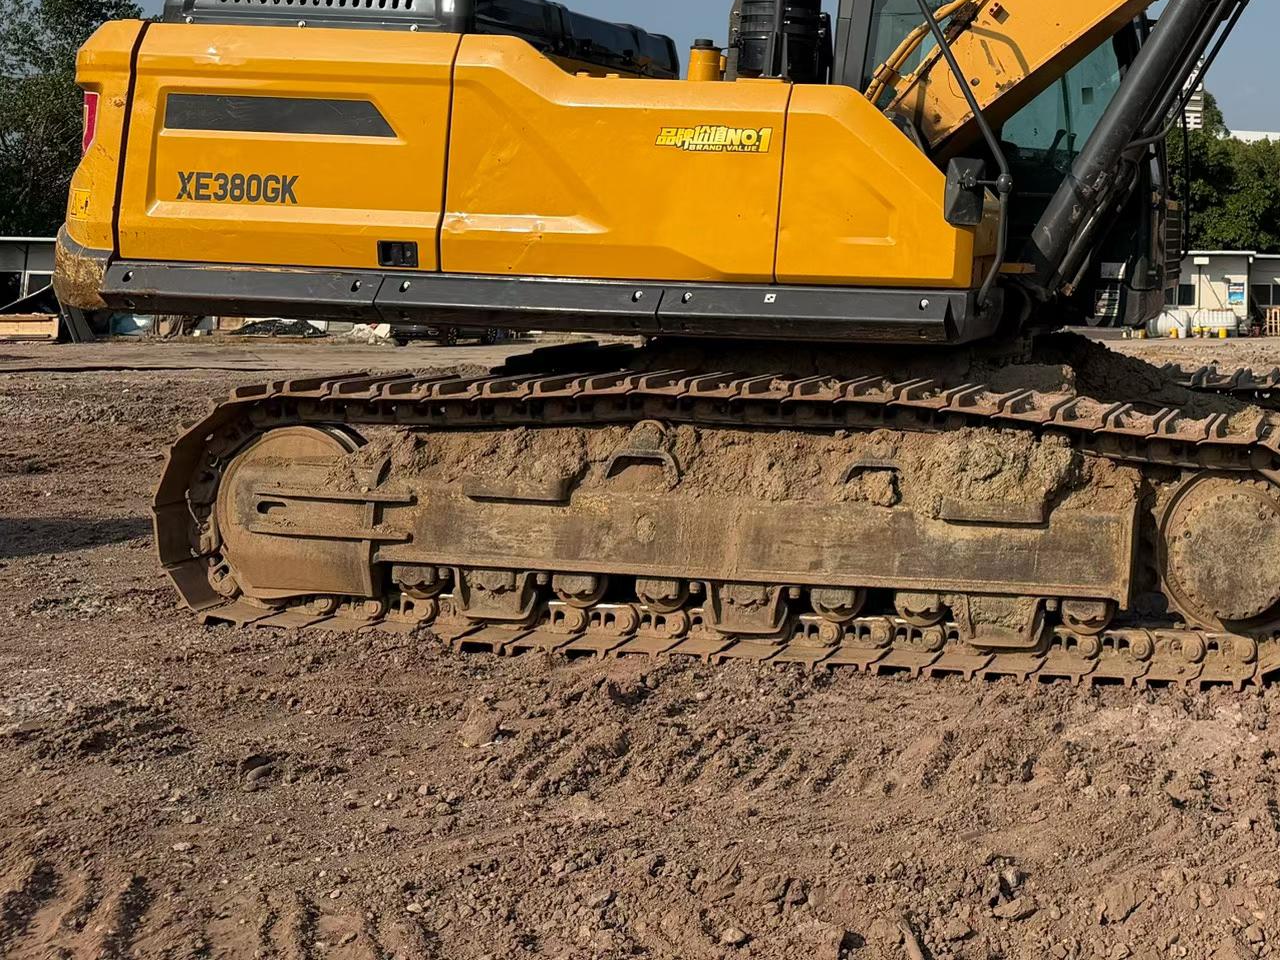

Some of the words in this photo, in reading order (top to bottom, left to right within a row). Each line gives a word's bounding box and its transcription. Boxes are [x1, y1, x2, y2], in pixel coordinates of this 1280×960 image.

[689, 144, 722, 152] BRAND
[726, 144, 757, 152] VALUE
[176, 171, 299, 204] XE380GK
